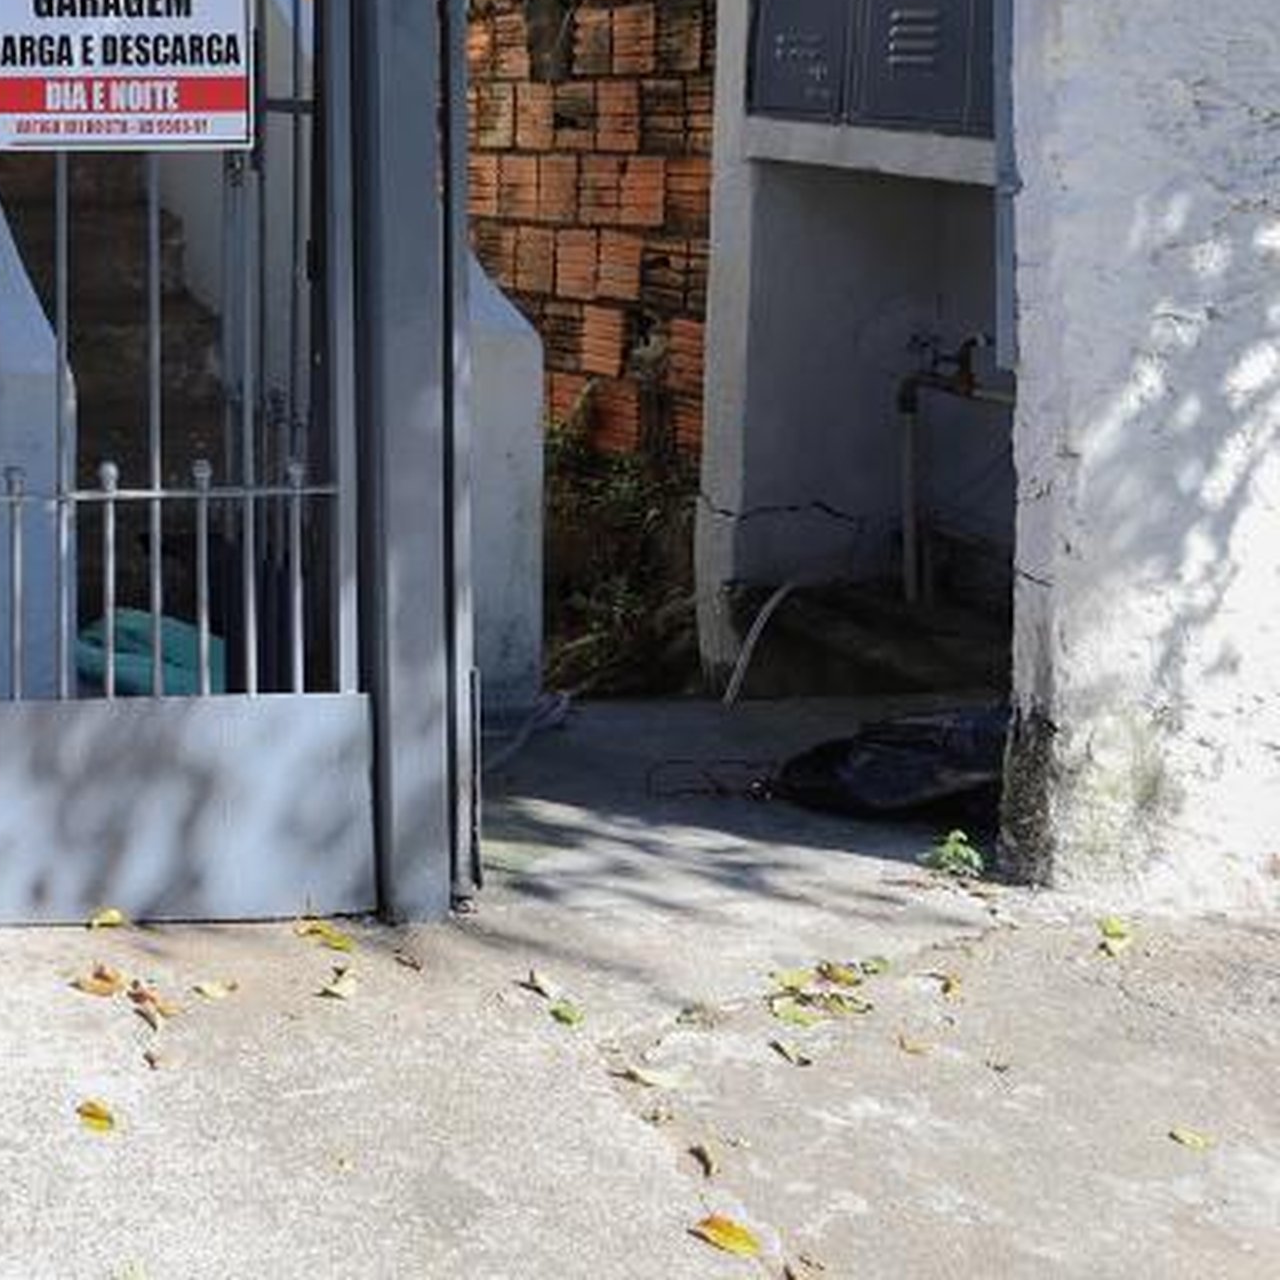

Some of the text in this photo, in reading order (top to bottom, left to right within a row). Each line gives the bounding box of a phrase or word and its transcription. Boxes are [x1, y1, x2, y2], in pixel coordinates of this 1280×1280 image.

[82, 34, 95, 65] E
[102, 33, 241, 66] DESCARGA
[46, 80, 179, 111] DIA E NOITE
